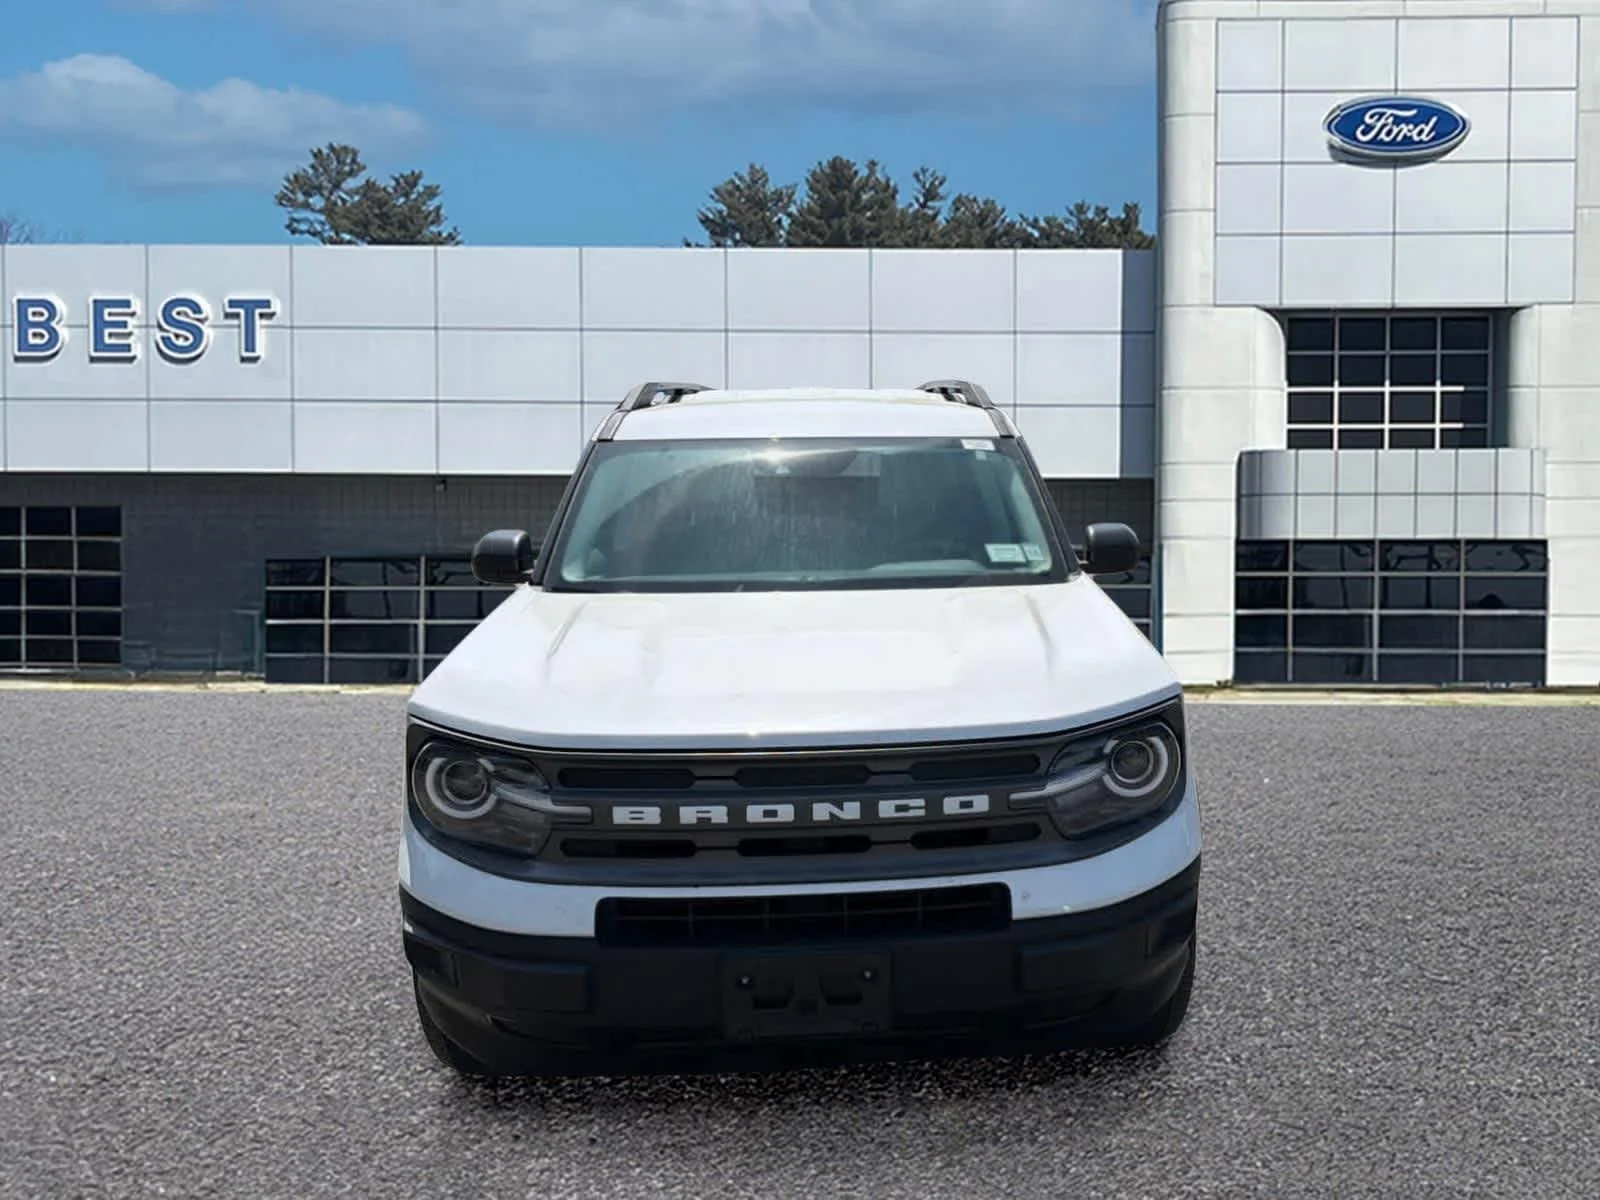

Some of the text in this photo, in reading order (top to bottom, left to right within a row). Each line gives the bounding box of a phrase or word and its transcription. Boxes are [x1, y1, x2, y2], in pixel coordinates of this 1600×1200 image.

[1356, 107, 1438, 142] Ford
[13, 294, 278, 363] BEST
[612, 795, 990, 825] BRONCO
